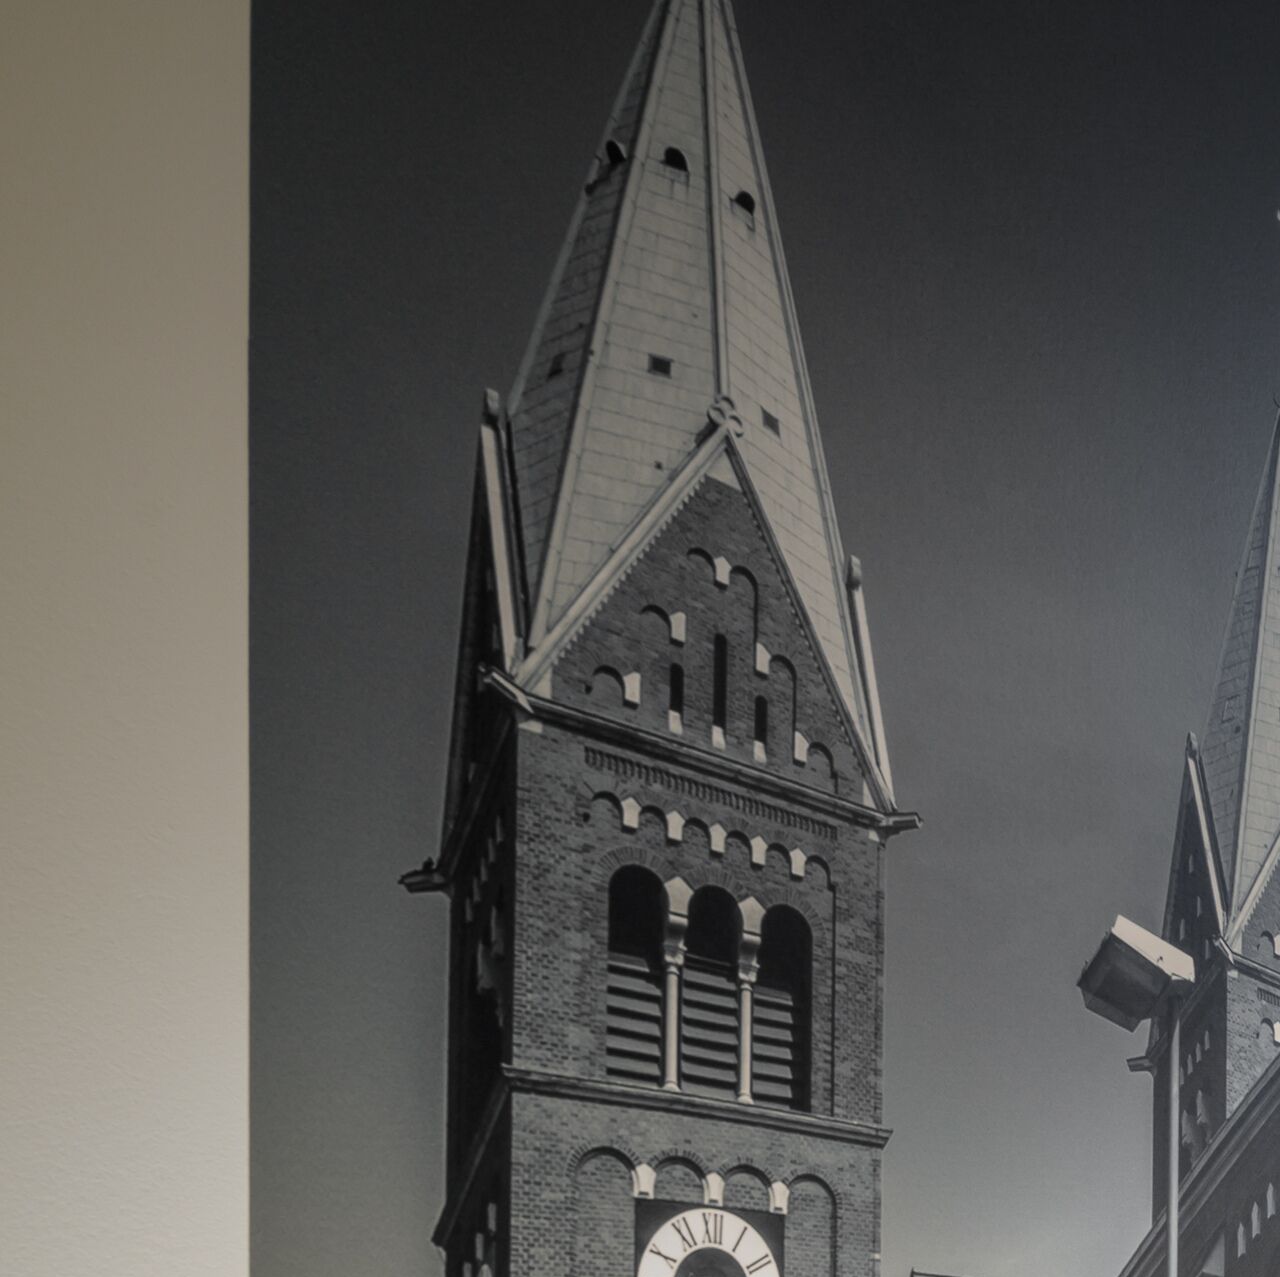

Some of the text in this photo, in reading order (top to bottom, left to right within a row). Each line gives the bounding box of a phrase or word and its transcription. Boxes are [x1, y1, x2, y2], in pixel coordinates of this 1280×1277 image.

[671, 1216, 698, 1252] XI
[702, 1212, 724, 1245] XII
[649, 1243, 677, 1270] X
[746, 1254, 772, 1275] II
